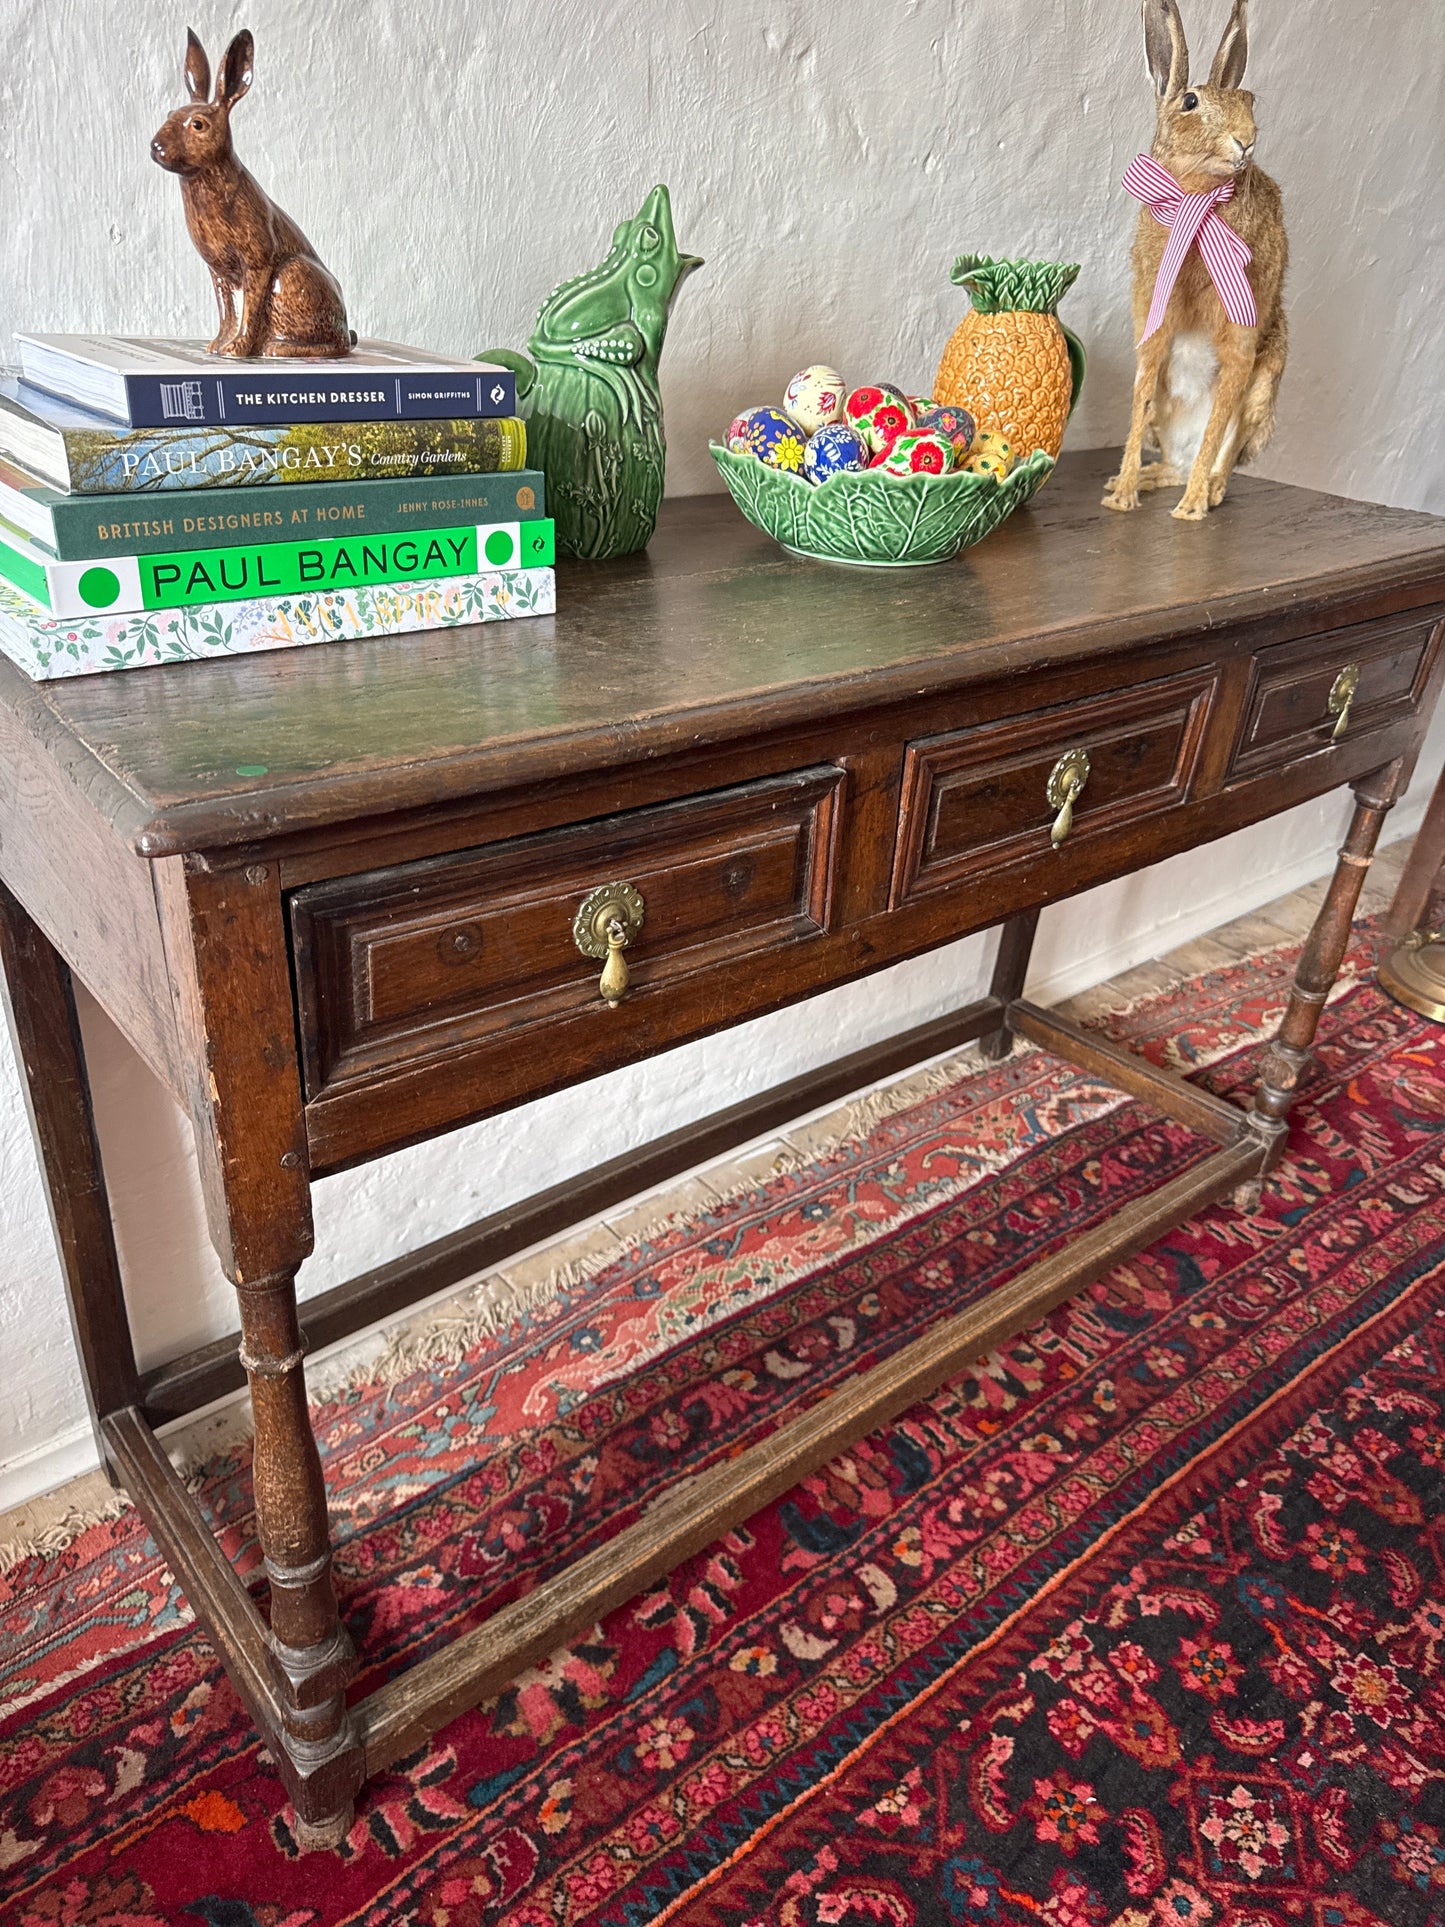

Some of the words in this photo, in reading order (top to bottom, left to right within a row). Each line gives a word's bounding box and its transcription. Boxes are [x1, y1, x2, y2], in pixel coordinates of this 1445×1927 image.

[236, 393, 263, 405] THE
[267, 392, 326, 404] KITCHEN
[330, 391, 386, 403] DRESSER
[408, 392, 432, 400] SIMON
[434, 391, 471, 400] GRIFFITHS
[122, 451, 208, 477] PAUL
[371, 453, 419, 468] Country
[420, 449, 467, 464] Gardens
[397, 501, 427, 513] JENNY
[432, 497, 489, 511] ROSE-INNES
[98, 520, 174, 540] BRITISH
[183, 511, 283, 533] DESIGNERS
[291, 509, 308, 524] AT
[317, 504, 366, 522] HOME
[152, 556, 281, 598] PAUL
[298, 536, 469, 582] BANGAY
[375, 588, 462, 627] SPIRO
